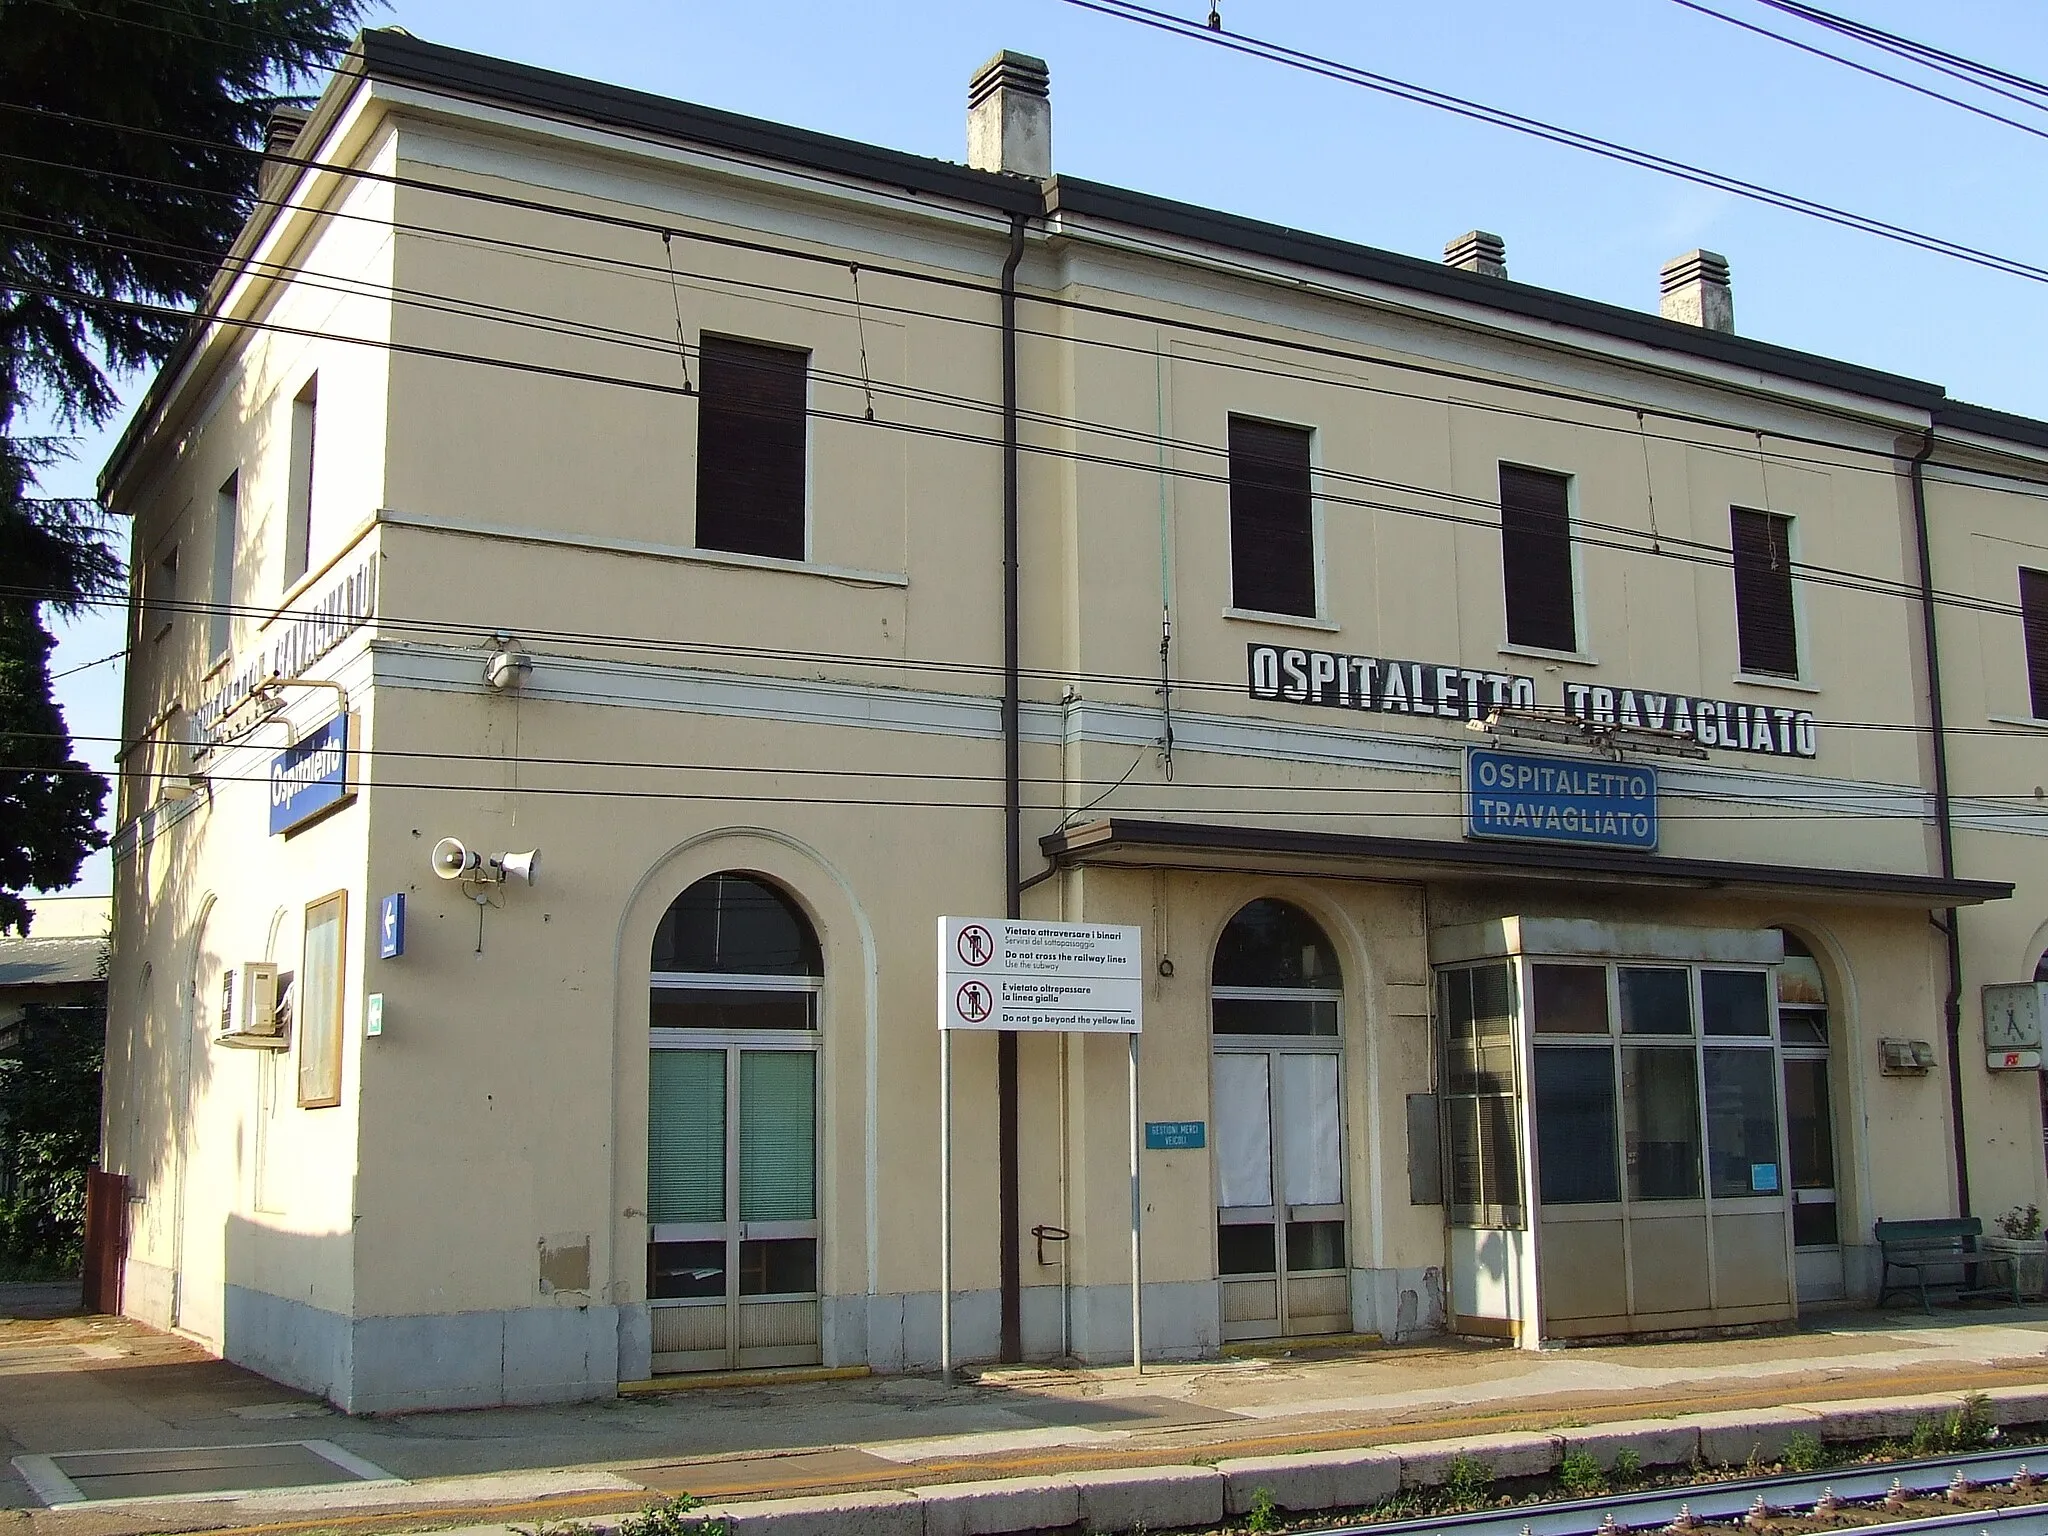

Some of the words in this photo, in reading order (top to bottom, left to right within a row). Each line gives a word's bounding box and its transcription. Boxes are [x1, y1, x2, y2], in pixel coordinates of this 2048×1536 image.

[1253, 647, 1534, 718] OSPITALETTO
[1567, 684, 1816, 755] TRAVAGLIATO
[271, 737, 341, 810] Ospitaletto
[1478, 761, 1648, 801] OSPITALETTO
[1478, 798, 1649, 838] TRAVAGLIATO
[1005, 927, 1036, 935] Vietato
[1038, 929, 1090, 938] attraversare
[1097, 931, 1121, 940] binari
[1005, 936, 1030, 944] Servirsi
[1032, 937, 1043, 945] del
[1045, 938, 1095, 949] sottopassaggio
[1006, 951, 1017, 959] Do
[1058, 953, 1072, 961] the
[1074, 954, 1105, 964] railway
[1107, 954, 1126, 963] lines
[1005, 960, 1018, 968] Use
[1020, 961, 1031, 969] the
[1033, 962, 1059, 971] subway
[1009, 984, 1038, 992] vietato
[1040, 984, 1091, 994] oltrepassare
[1003, 993, 1011, 1001] la
[1012, 993, 1033, 1001] linea
[1035, 994, 1058, 1004] gialla
[1003, 1014, 1014, 1022] Do
[1016, 1015, 1030, 1023] not
[1032, 1017, 1043, 1025] go
[1045, 1015, 1076, 1026] beyond
[1077, 1016, 1091, 1024] the
[1092, 1016, 1119, 1026] yellow
[1121, 1017, 1135, 1025] line
